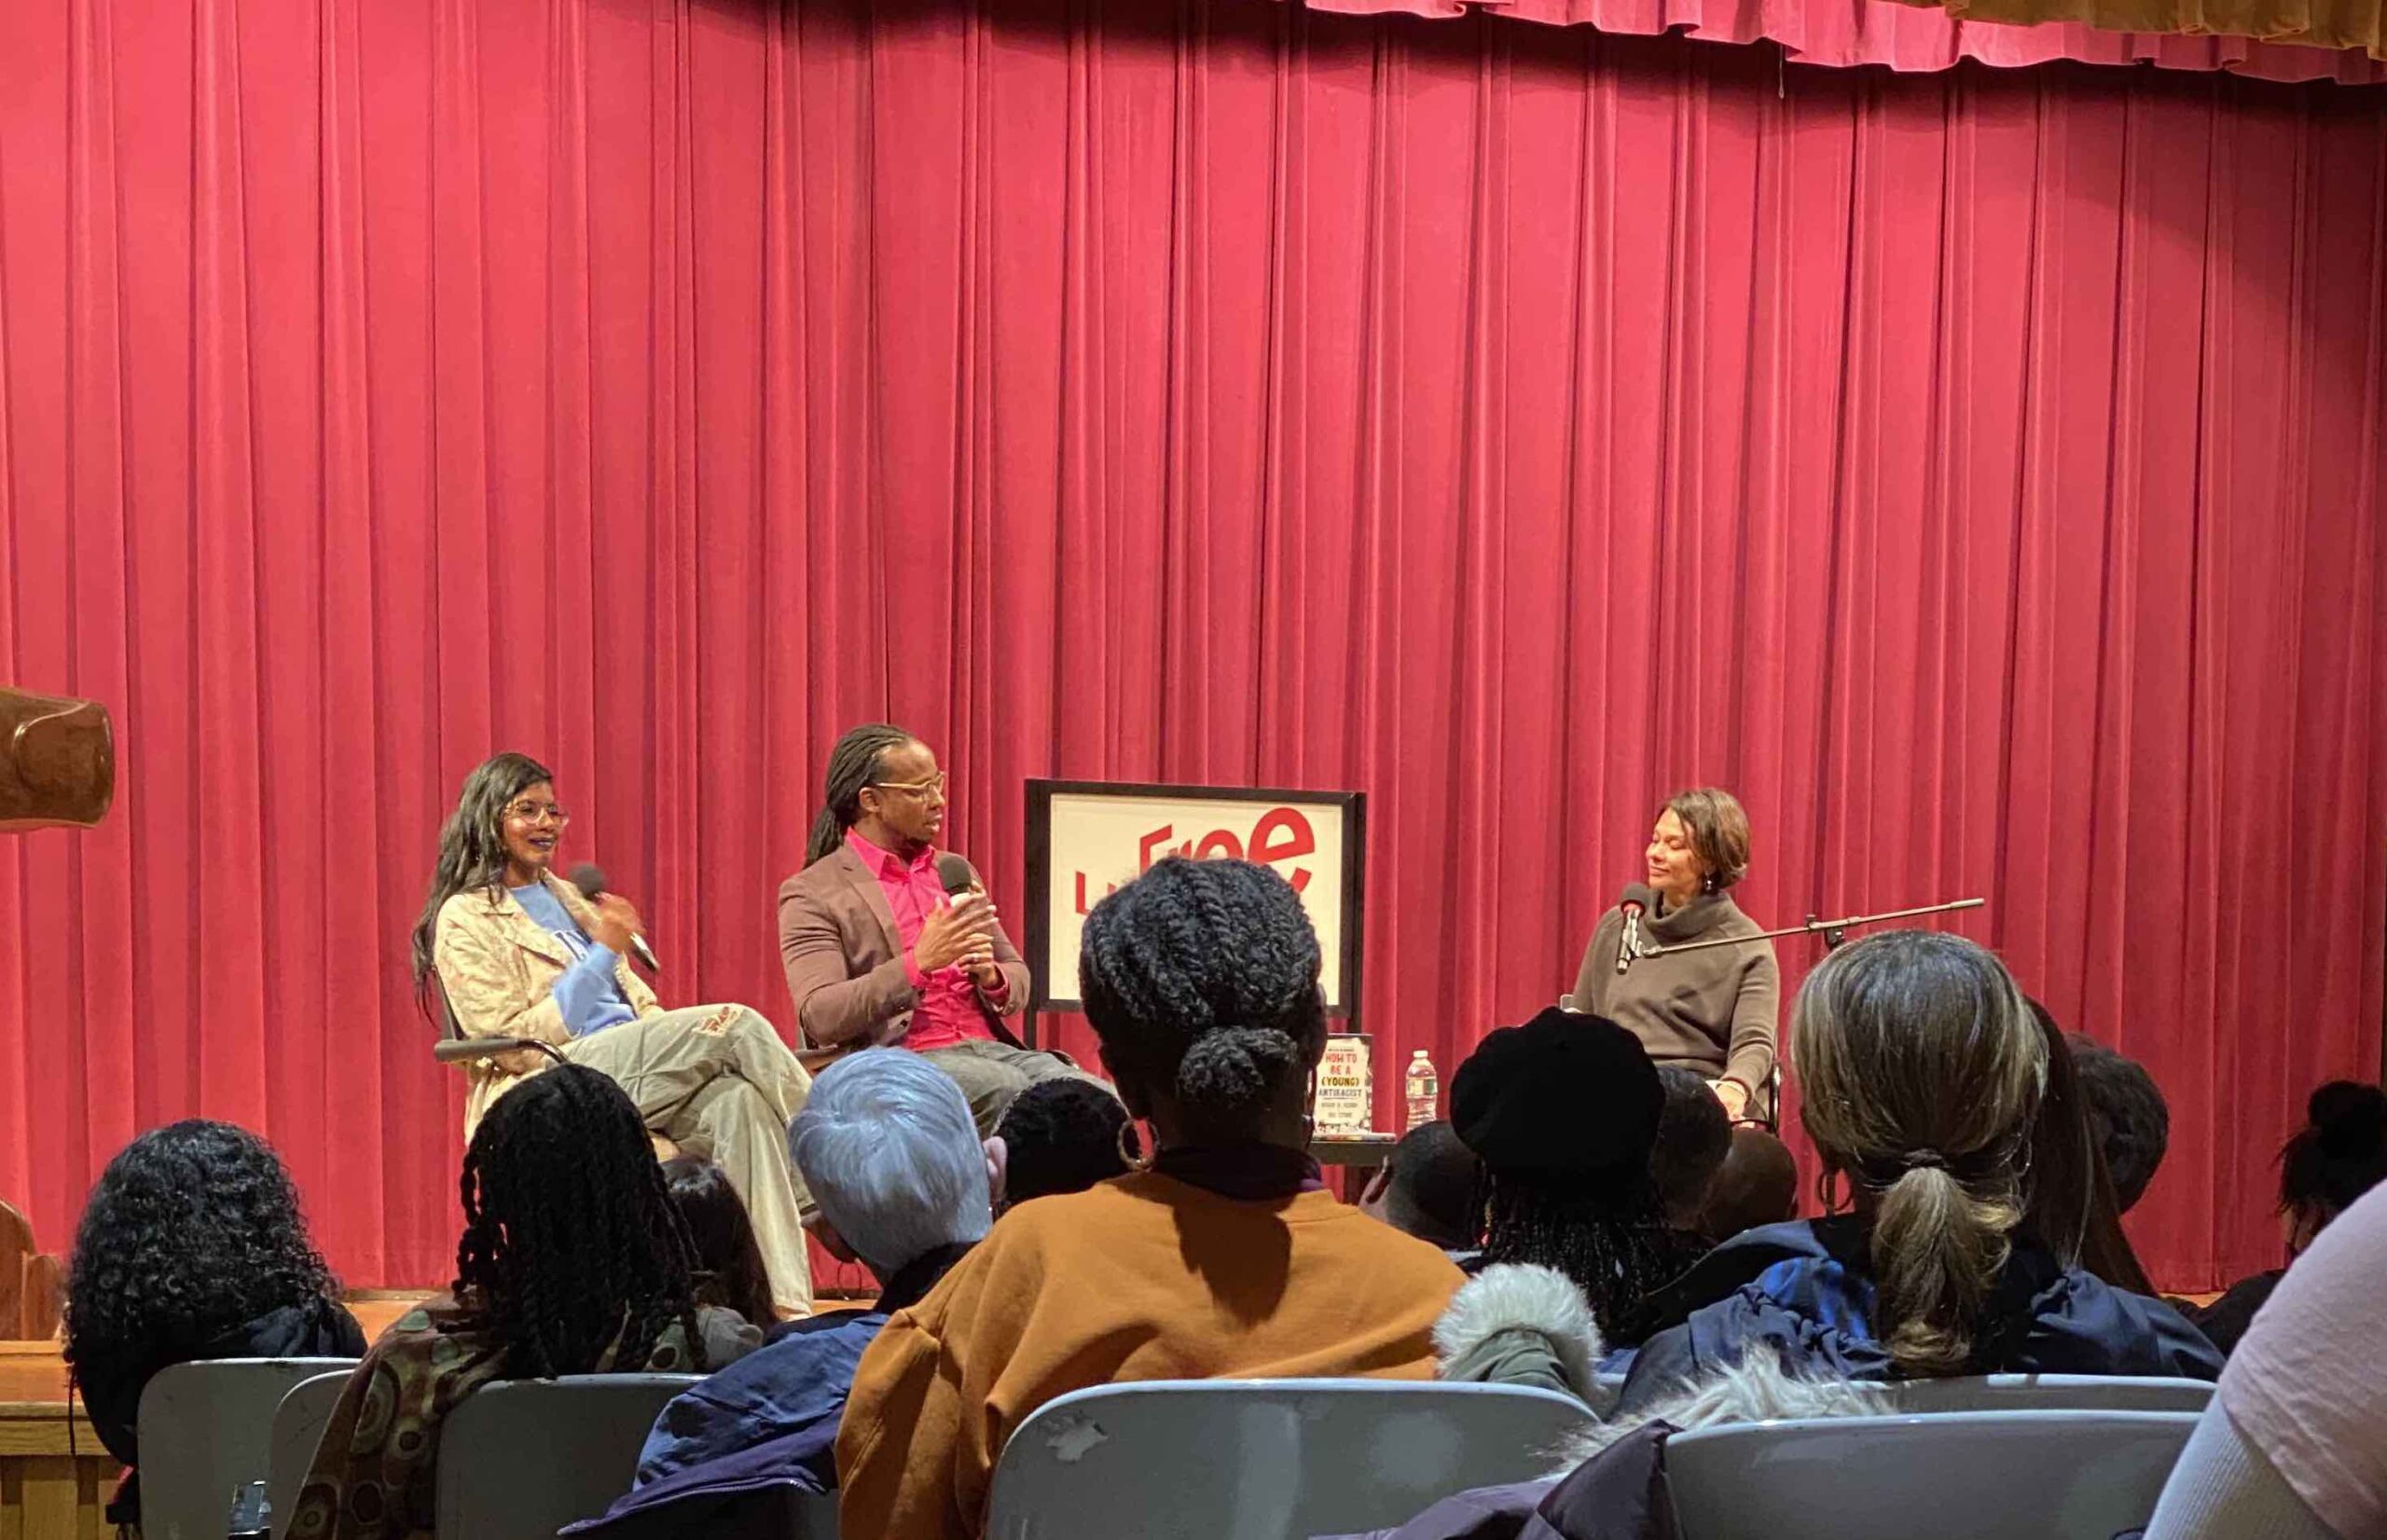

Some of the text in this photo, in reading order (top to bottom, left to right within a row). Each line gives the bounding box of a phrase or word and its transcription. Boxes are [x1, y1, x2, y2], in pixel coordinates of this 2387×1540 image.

[1326, 1053, 1357, 1064] HOW TO
[1345, 1066, 1351, 1075] A
[1321, 1077, 1359, 1087] (YOUNG)
